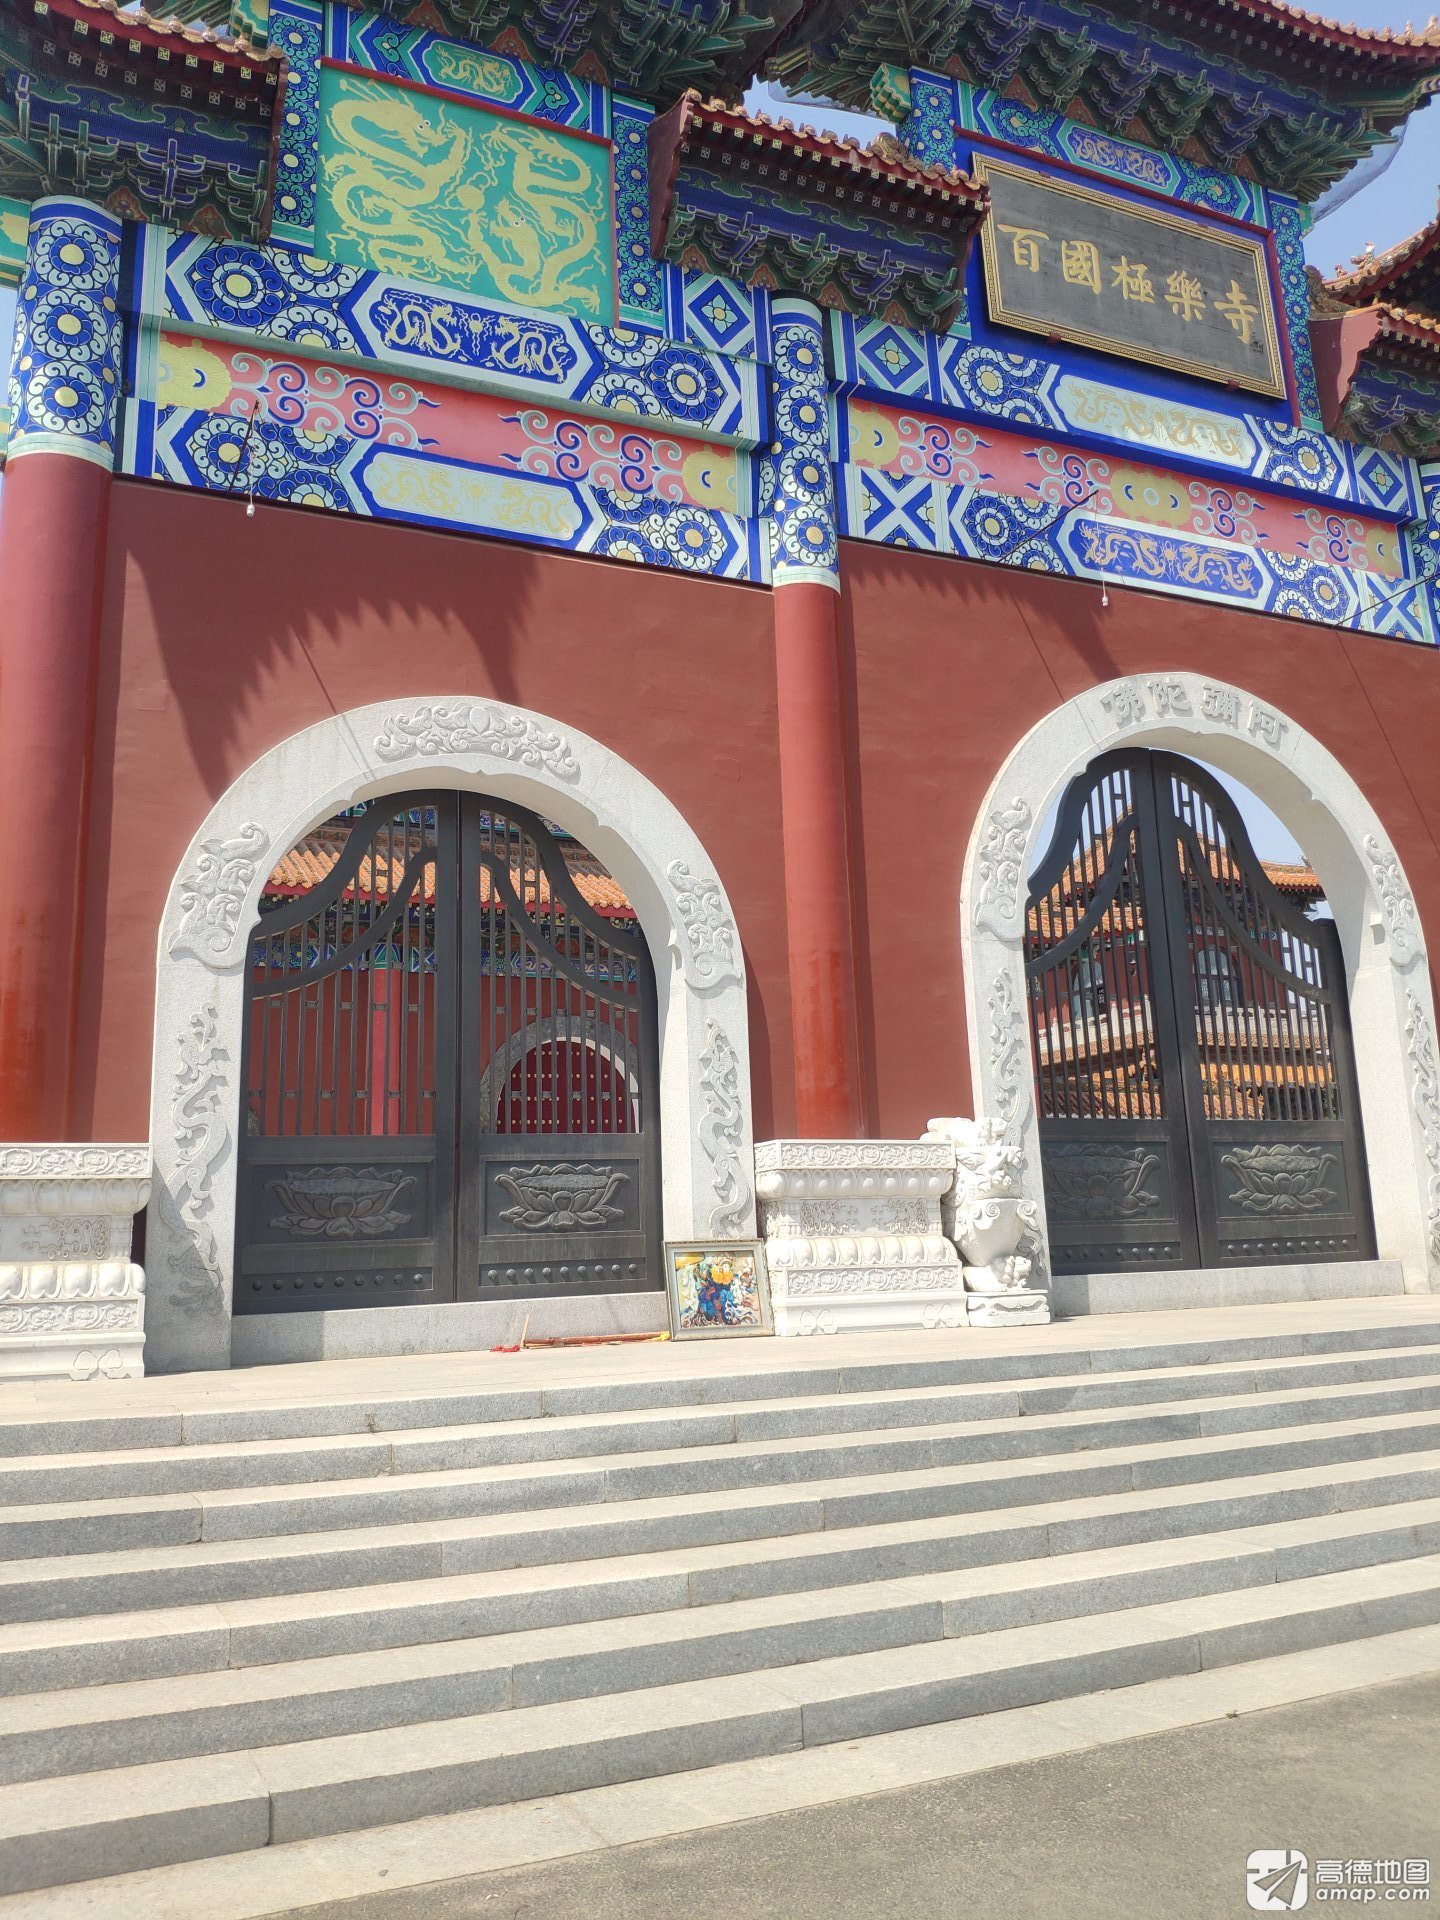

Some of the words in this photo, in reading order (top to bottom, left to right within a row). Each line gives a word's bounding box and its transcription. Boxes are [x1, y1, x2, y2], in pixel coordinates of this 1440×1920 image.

[997, 223, 1259, 344] 百國極樂寺
